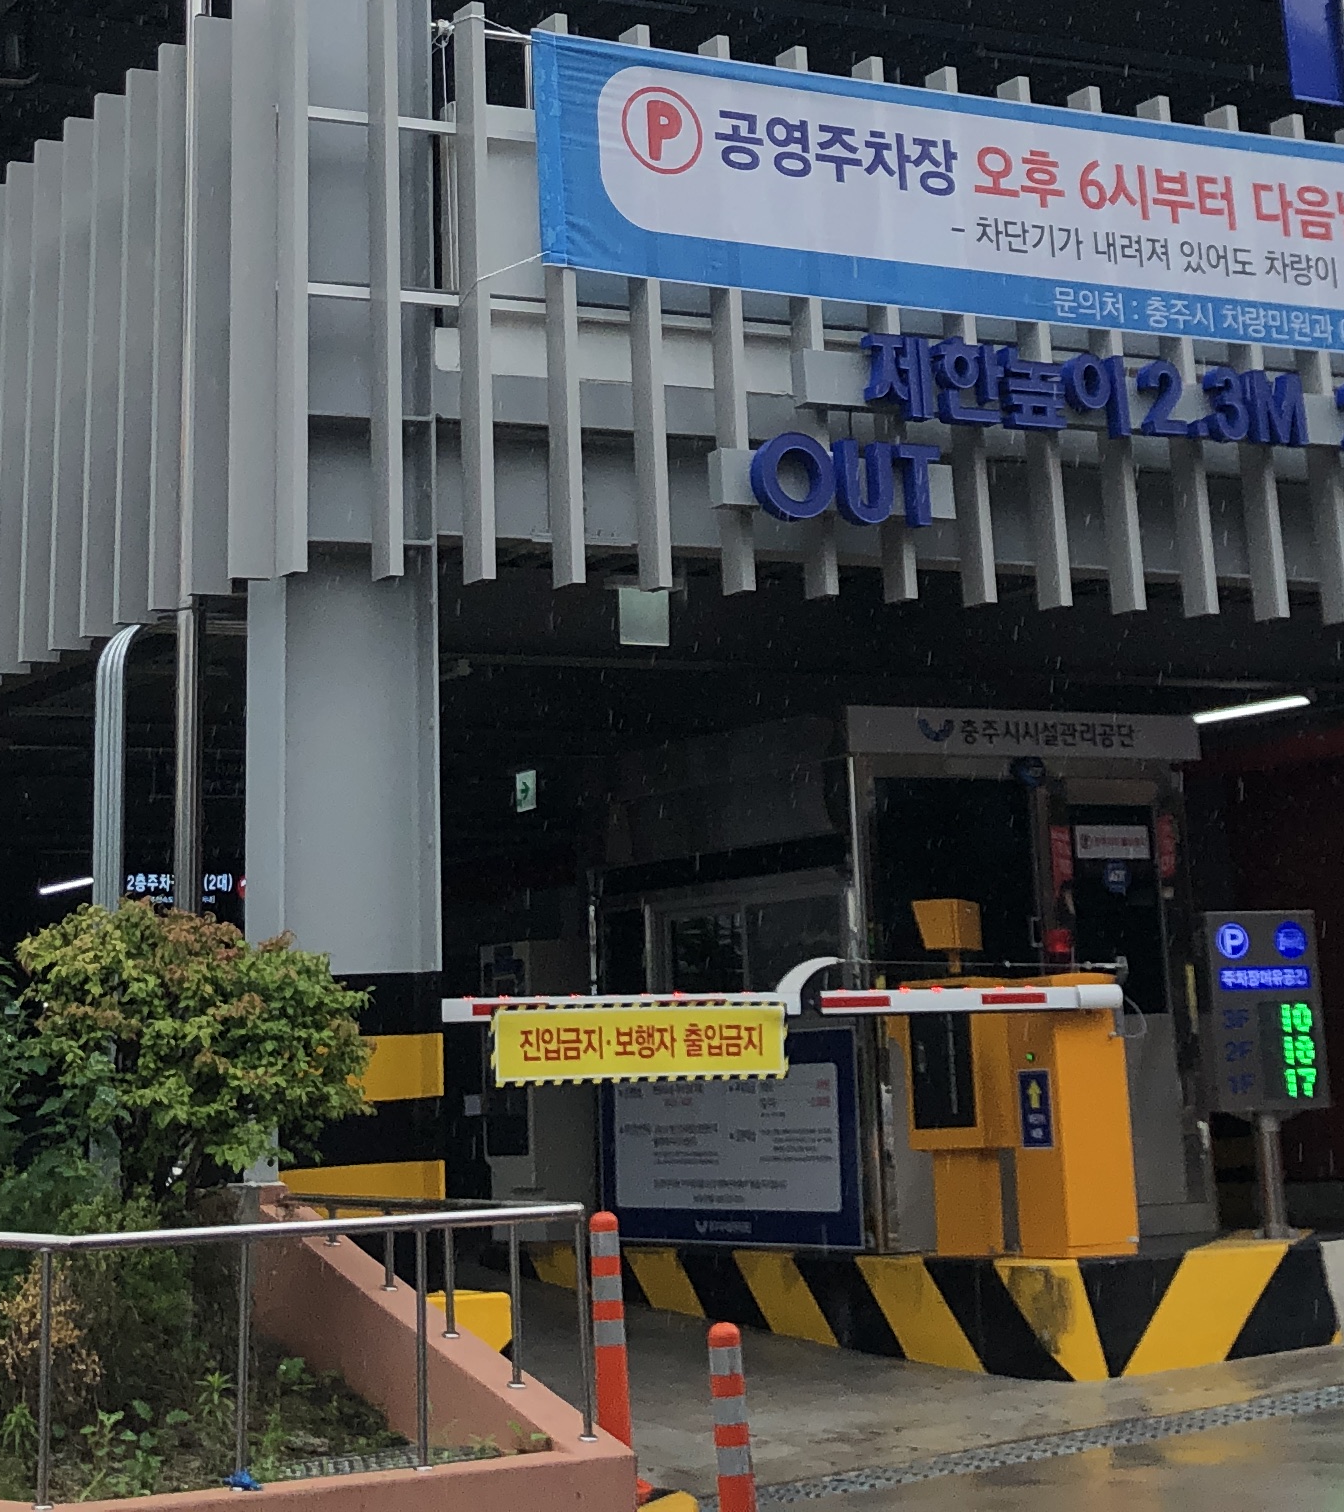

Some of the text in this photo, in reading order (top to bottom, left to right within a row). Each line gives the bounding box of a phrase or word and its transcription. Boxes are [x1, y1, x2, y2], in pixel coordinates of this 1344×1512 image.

[714, 108, 958, 196] 공영주차장
[974, 145, 1065, 209] 오후
[1078, 158, 1236, 232] 6시부터
[976, 216, 1083, 261] 차단기가
[1093, 229, 1171, 272] 내려져
[1180, 238, 1256, 279] 있어도
[1264, 248, 1338, 290] 차량이
[1054, 285, 1125, 323] 문의처
[1146, 296, 1216, 333] 충주시
[1221, 304, 1334, 345] 차량민원과
[749, 431, 940, 528] OUT
[959, 719, 1136, 749] 충주시시설관리공단
[126, 873, 233, 893] 2층주차 (2대)
[683, 1022, 764, 1057] 출입금지
